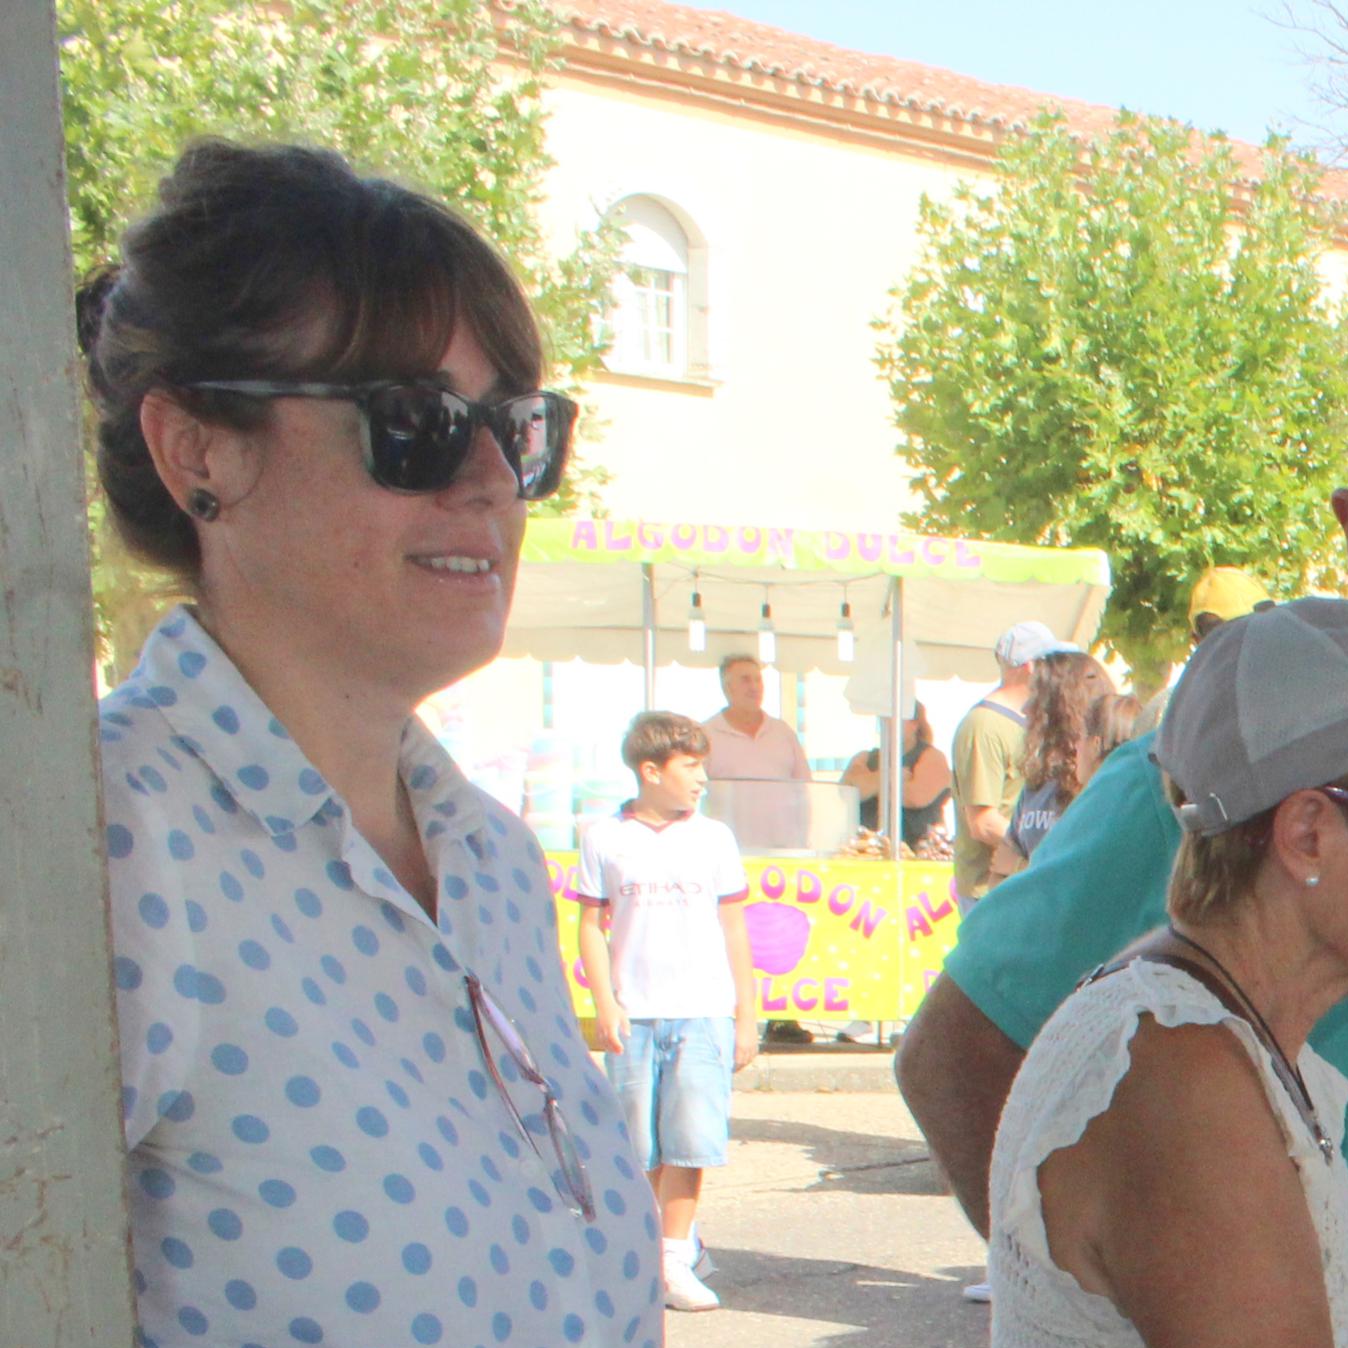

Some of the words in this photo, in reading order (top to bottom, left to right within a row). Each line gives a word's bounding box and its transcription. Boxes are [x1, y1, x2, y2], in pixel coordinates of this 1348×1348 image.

[571, 520, 795, 559] ALGODON
[825, 530, 981, 567] DULCE
[760, 864, 887, 939] ODON
[754, 977, 849, 1012] LCE
